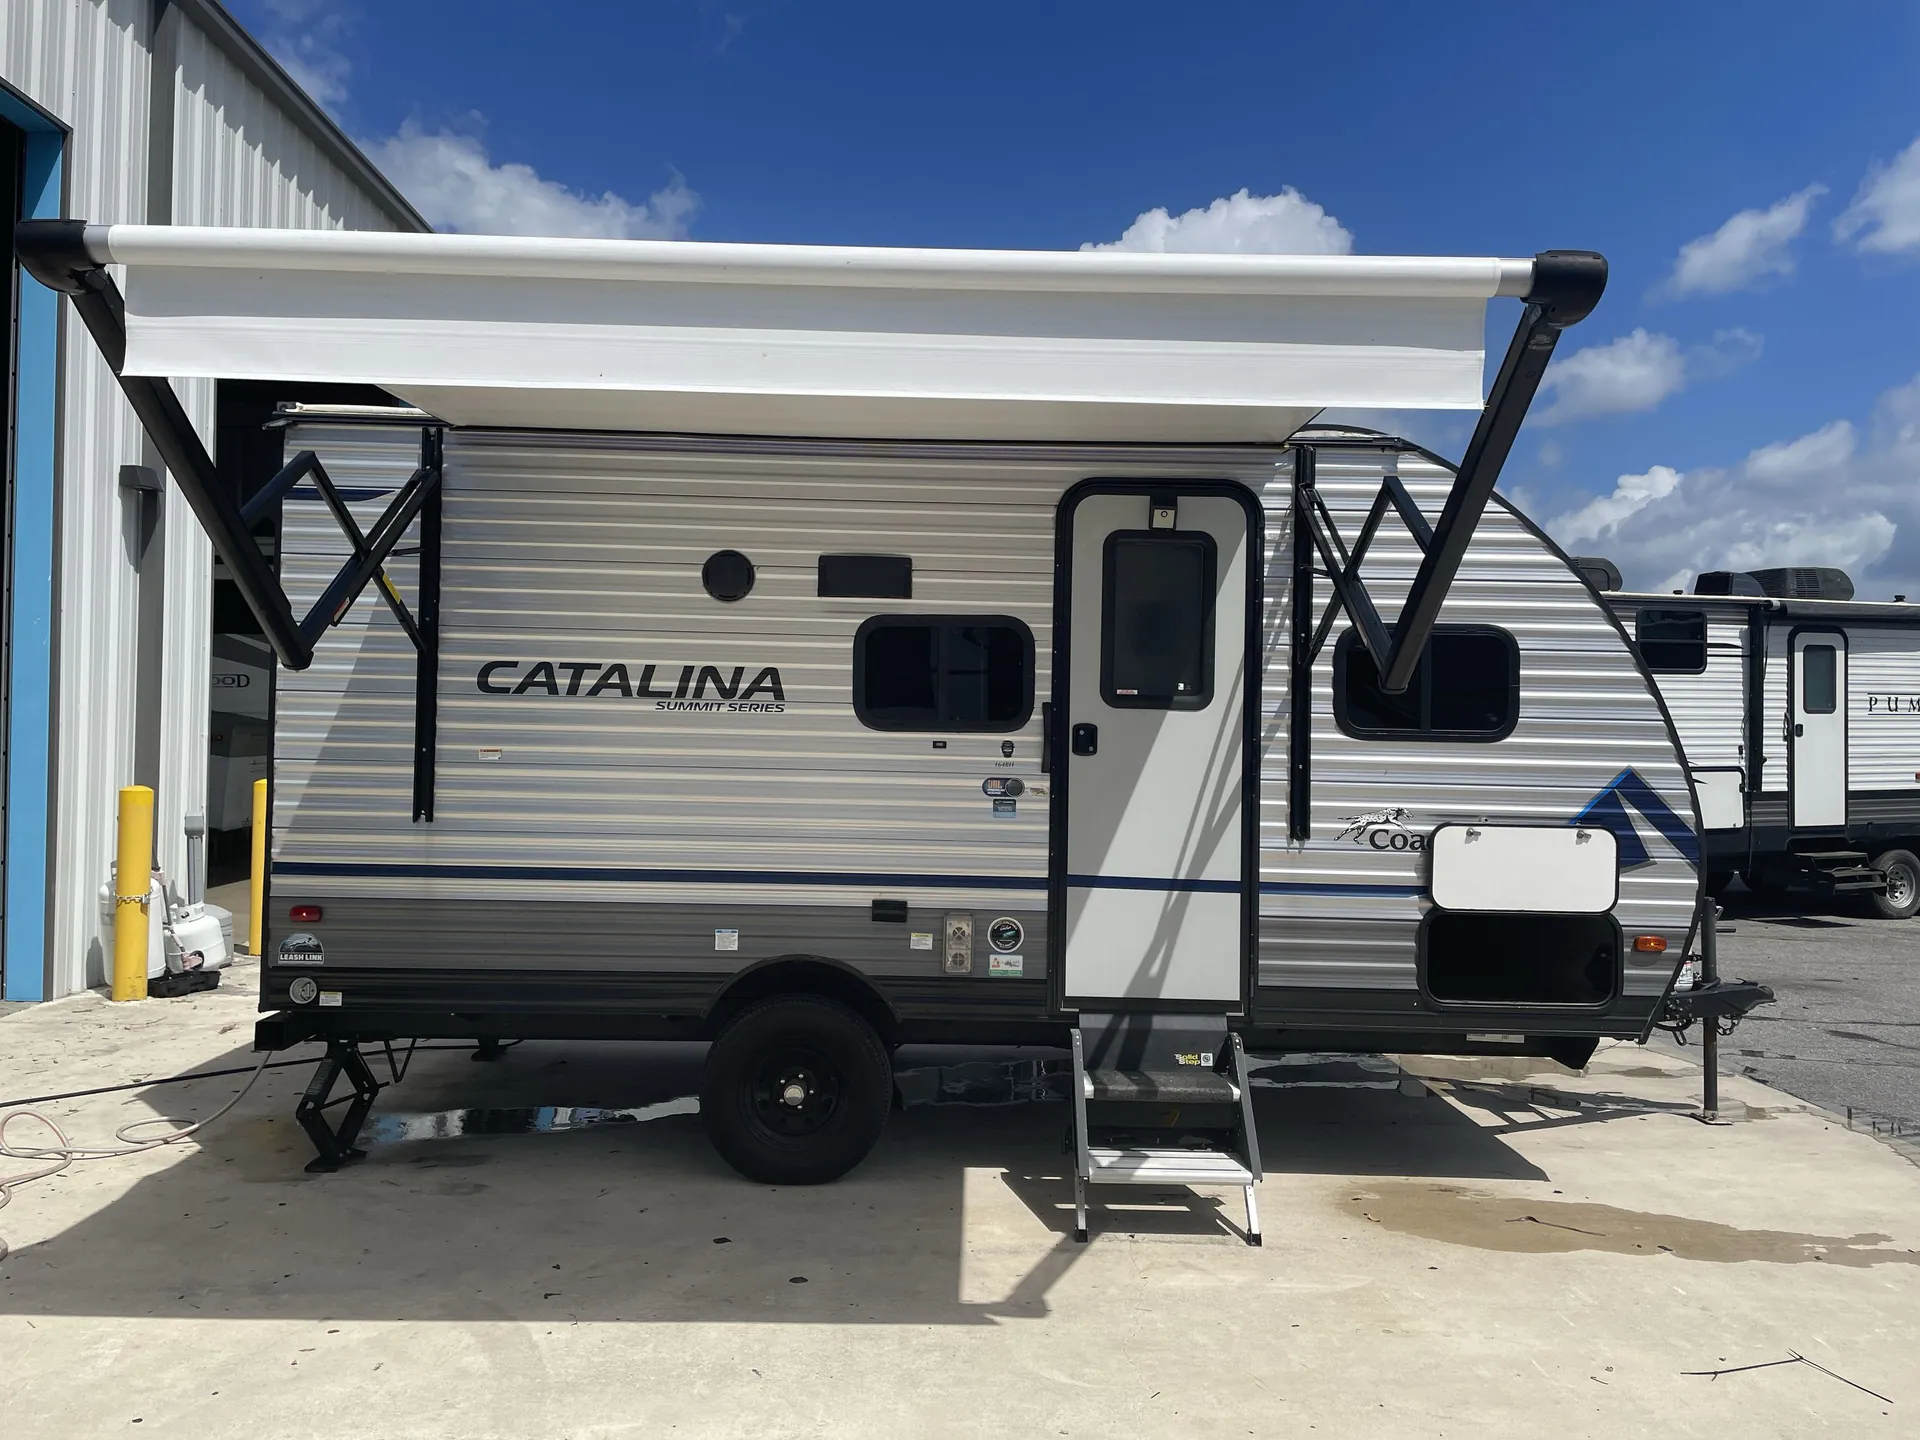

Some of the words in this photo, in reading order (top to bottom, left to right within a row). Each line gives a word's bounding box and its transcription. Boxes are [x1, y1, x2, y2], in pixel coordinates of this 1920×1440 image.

[476, 660, 786, 701] CATALINA
[655, 701, 723, 712] SUMMIT
[727, 702, 786, 713] SERIES
[1368, 828, 1431, 851] Coa
